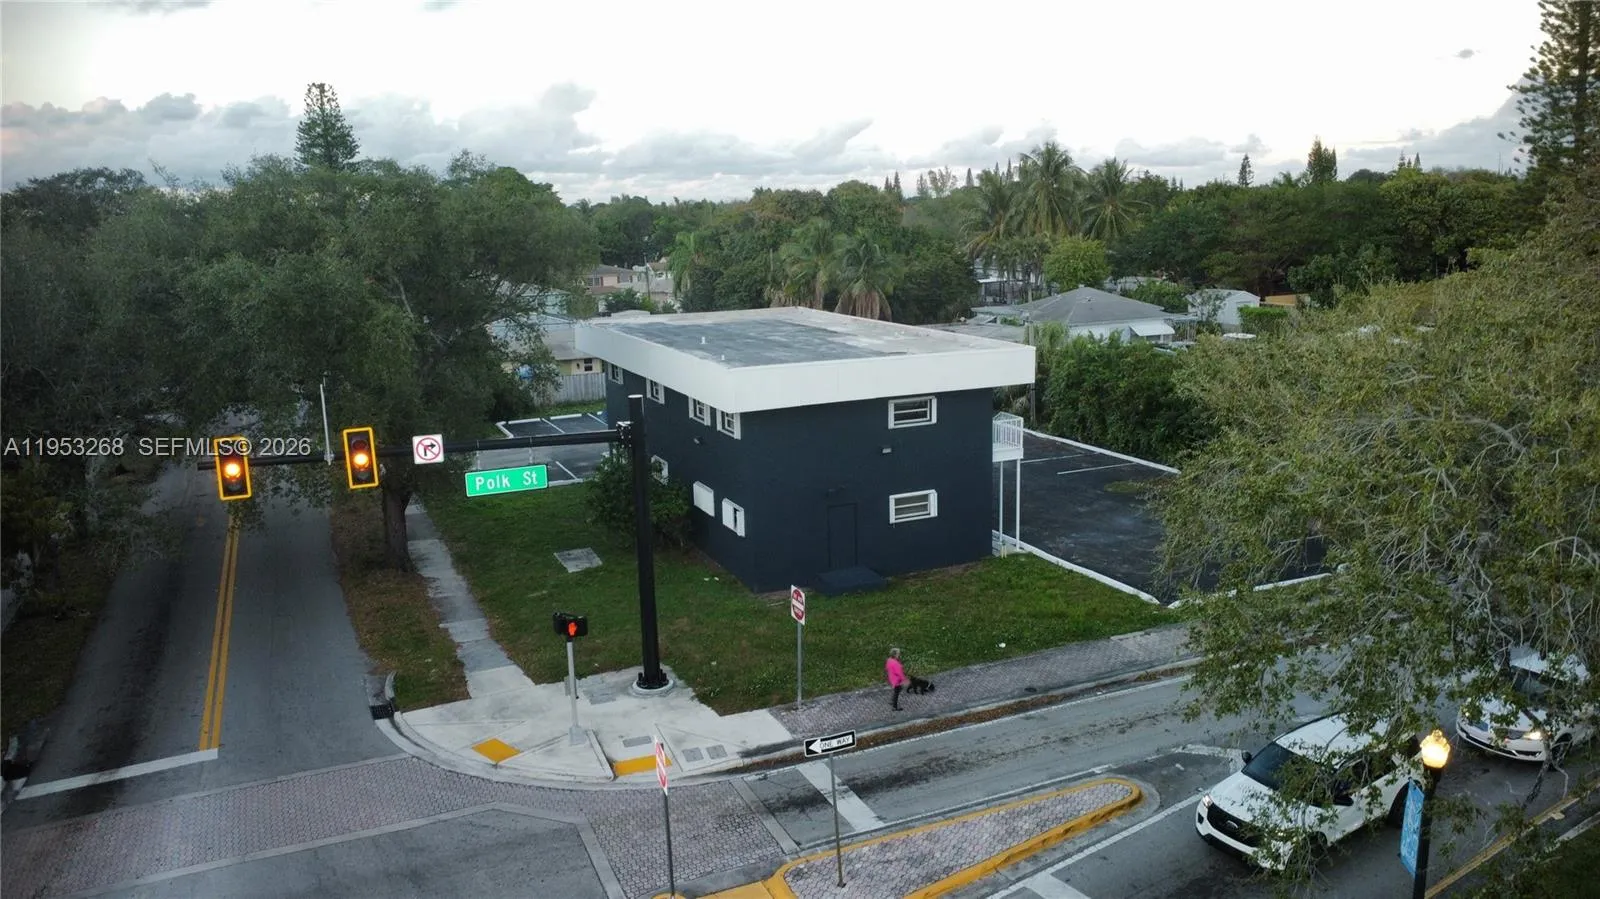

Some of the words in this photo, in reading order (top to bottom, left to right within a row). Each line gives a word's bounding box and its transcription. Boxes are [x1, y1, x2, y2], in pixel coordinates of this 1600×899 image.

[475, 474, 510, 491] Polk
[522, 471, 538, 486] St
[836, 736, 850, 745] WAY
